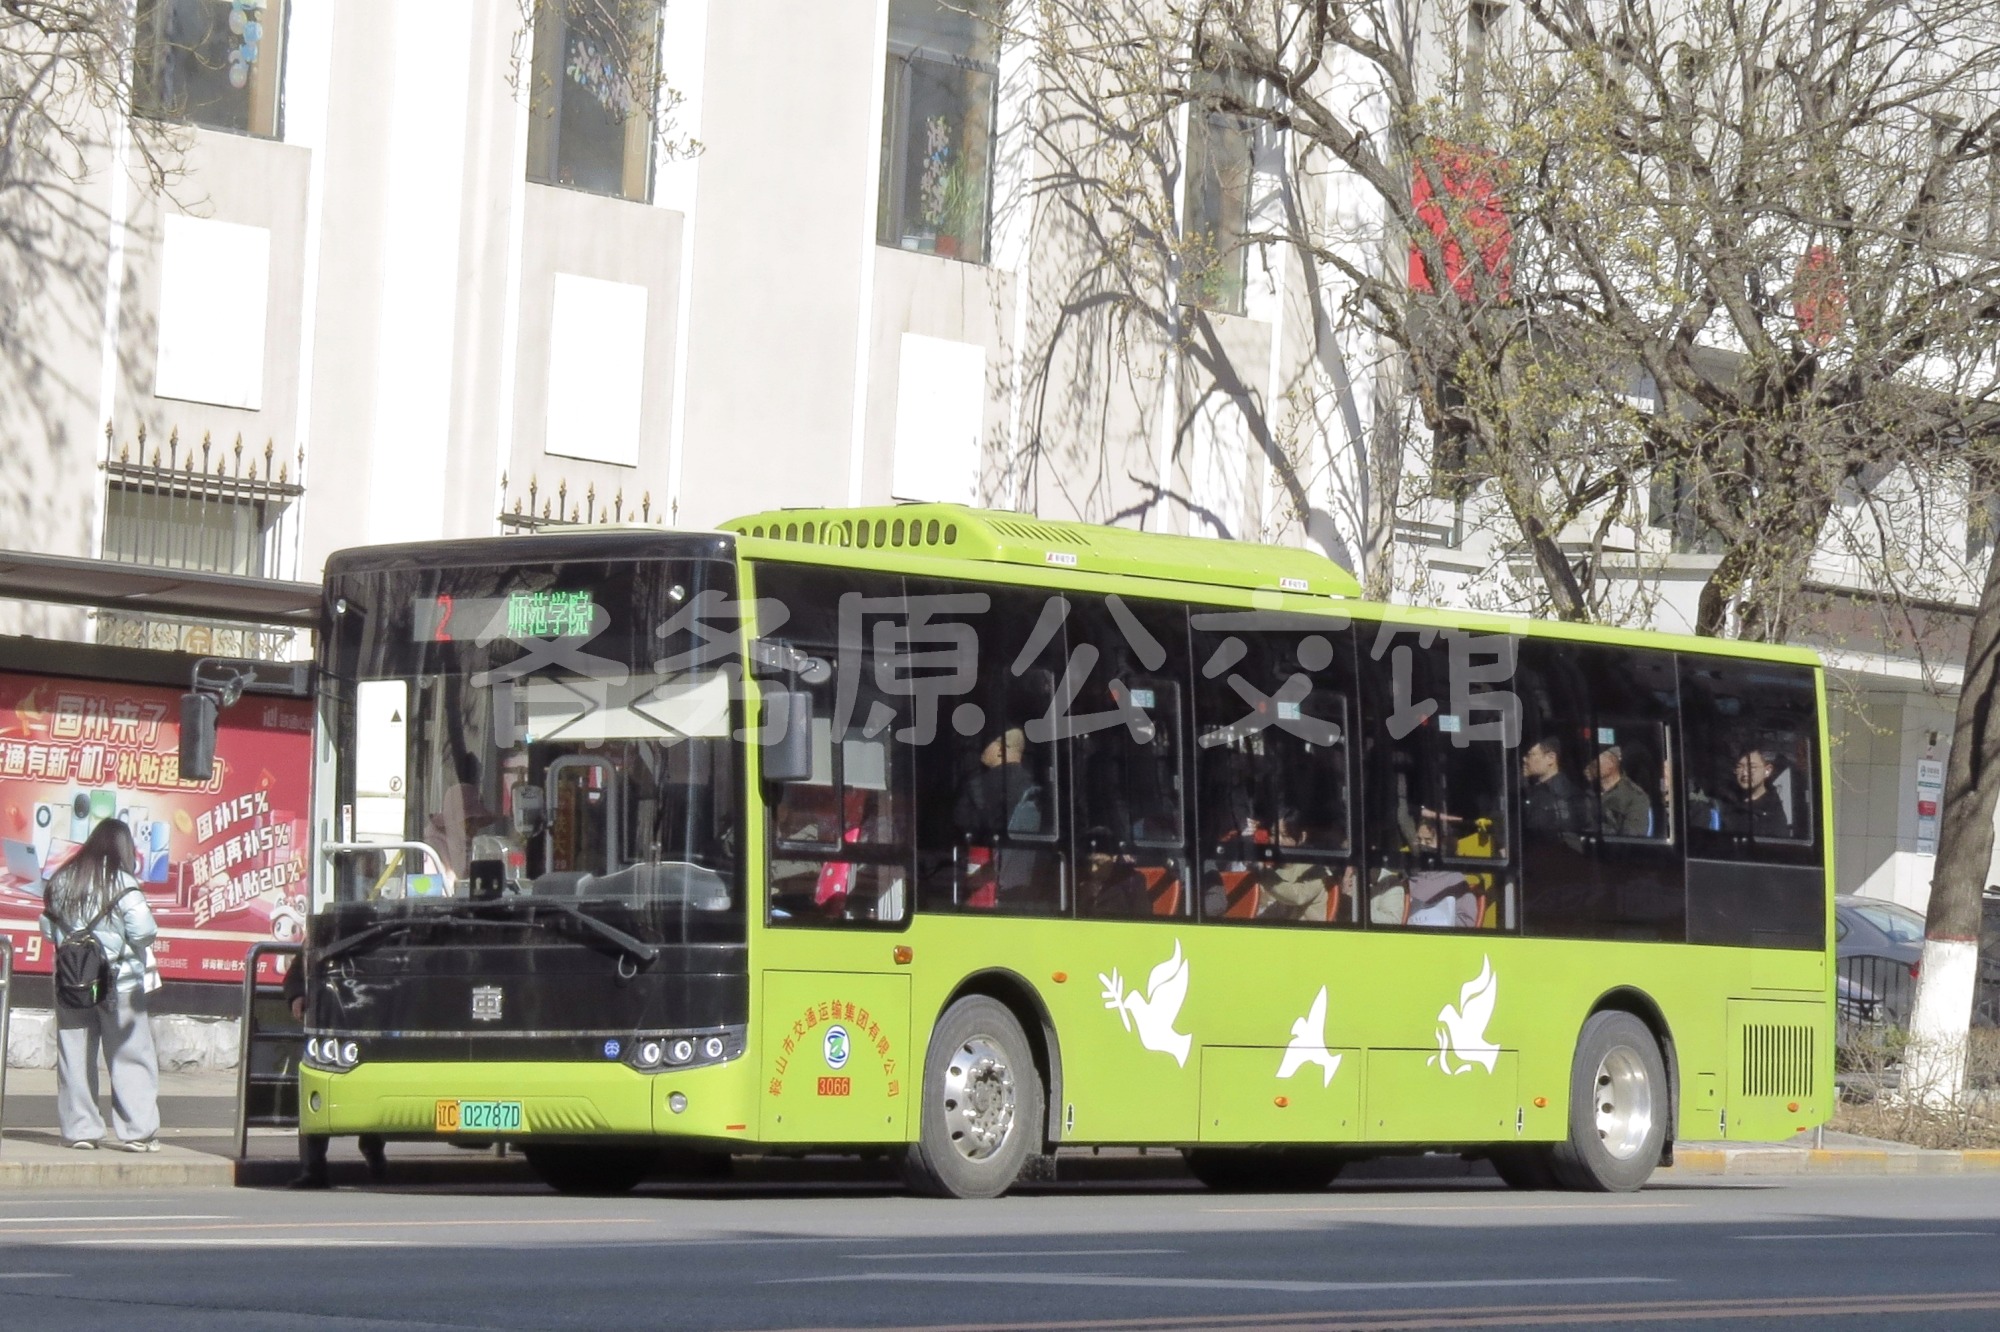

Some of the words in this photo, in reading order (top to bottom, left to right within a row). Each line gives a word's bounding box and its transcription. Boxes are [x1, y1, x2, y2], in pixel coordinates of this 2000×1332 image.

[435, 594, 453, 643] 2
[508, 590, 588, 637] 师范学院
[53, 695, 167, 743] 国补来了
[196, 790, 269, 843] 国补15%
[192, 823, 289, 887] 联通再补5%
[193, 861, 300, 928] 至高补贴20%
[769, 999, 899, 1097] 鞍山市交通运输集团有限公司
[819, 1077, 849, 1096] 3066
[464, 1105, 520, 1127] 02787D
